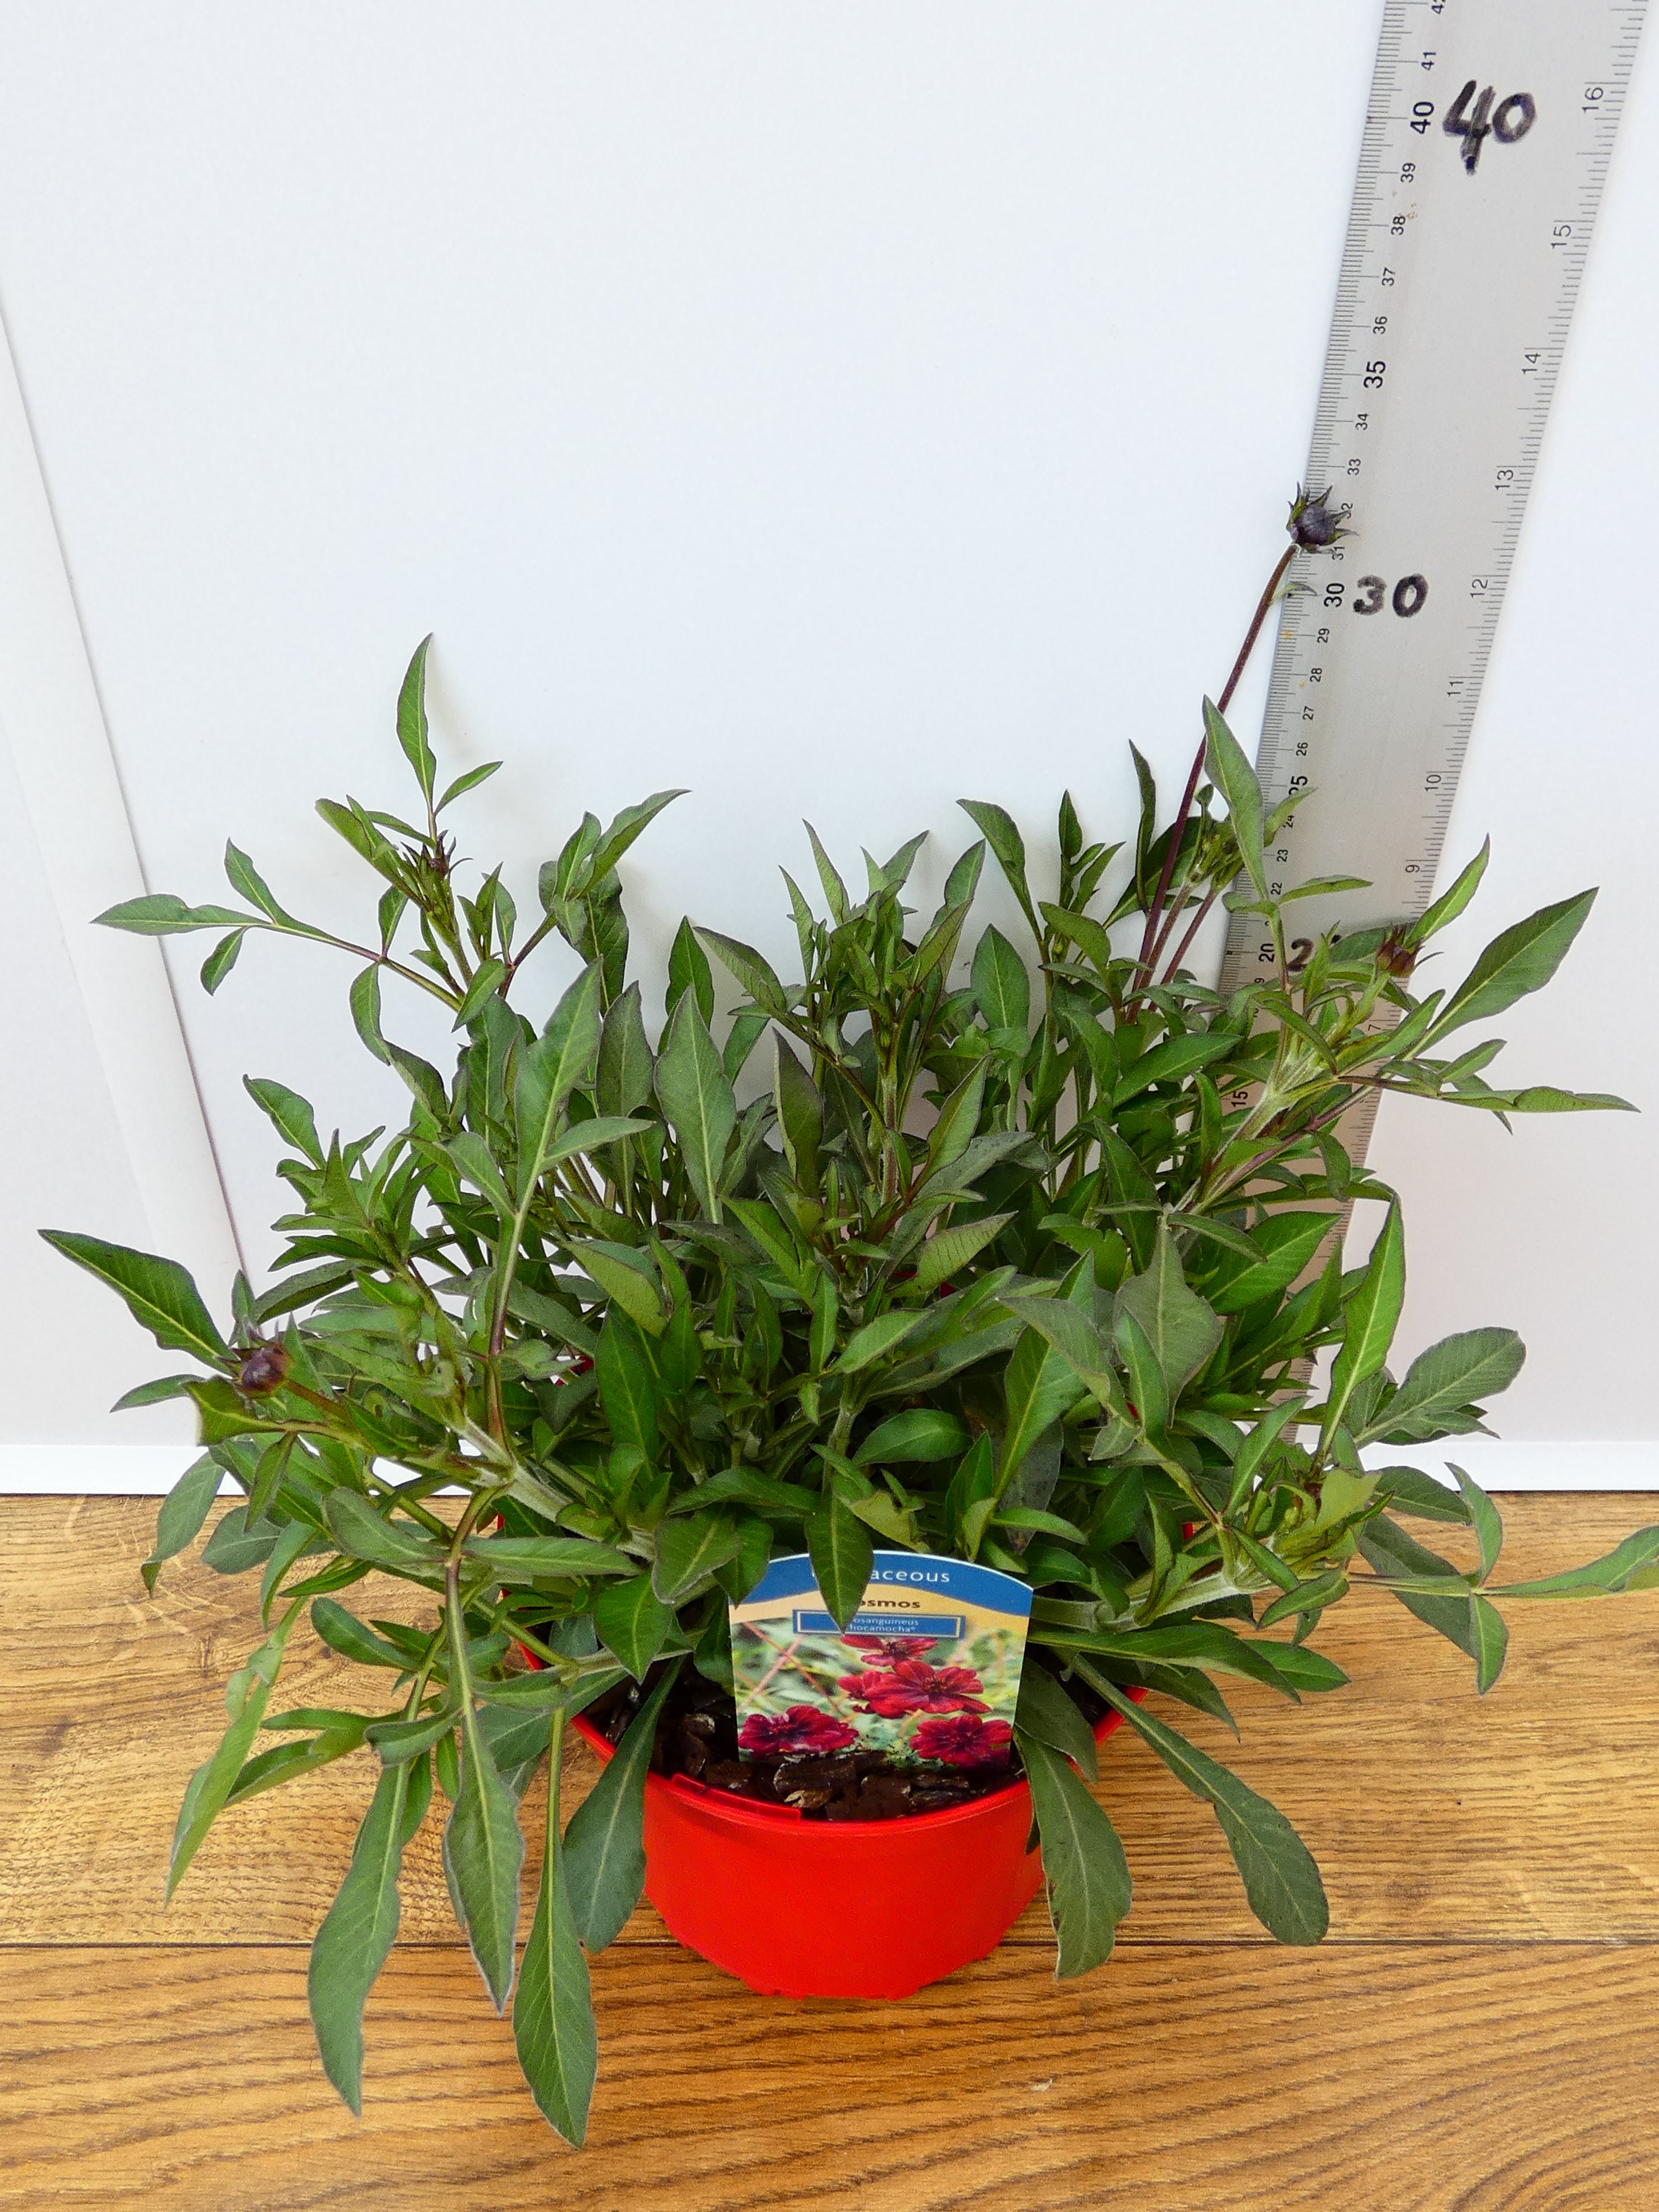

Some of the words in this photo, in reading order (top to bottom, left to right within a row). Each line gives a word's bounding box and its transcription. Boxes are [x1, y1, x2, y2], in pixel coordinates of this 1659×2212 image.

[1431, 0, 1445, 14] 4
[1421, 51, 1436, 70] 41
[1582, 87, 1604, 113] 16
[1410, 101, 1434, 134] 40
[1442, 80, 1537, 176] 40
[1401, 163, 1416, 183] 39
[1391, 216, 1406, 235] 38
[1551, 225, 1571, 249] 15
[1382, 267, 1396, 286] 37
[1373, 316, 1388, 334] 36
[1521, 353, 1541, 375] 14
[1364, 361, 1386, 389] 35
[1355, 413, 1369, 430] 34
[1347, 459, 1361, 475] 33
[1495, 469, 1514, 491] 13
[1324, 583, 1345, 607] 30
[1353, 573, 1429, 618] 30
[1470, 578, 1488, 598] 12
[1317, 628, 1330, 643] 29
[1310, 667, 1322, 682] 28
[1447, 681, 1464, 697] 11
[1303, 706, 1314, 720] 27
[1296, 742, 1308, 756] 26
[1424, 774, 1442, 792] 10
[1277, 849, 1289, 862] 23
[1405, 865, 1420, 873] 9
[1271, 882, 1283, 895] 22
[1231, 1091, 1248, 1107] 15
[871, 1570, 949, 1583] aceous
